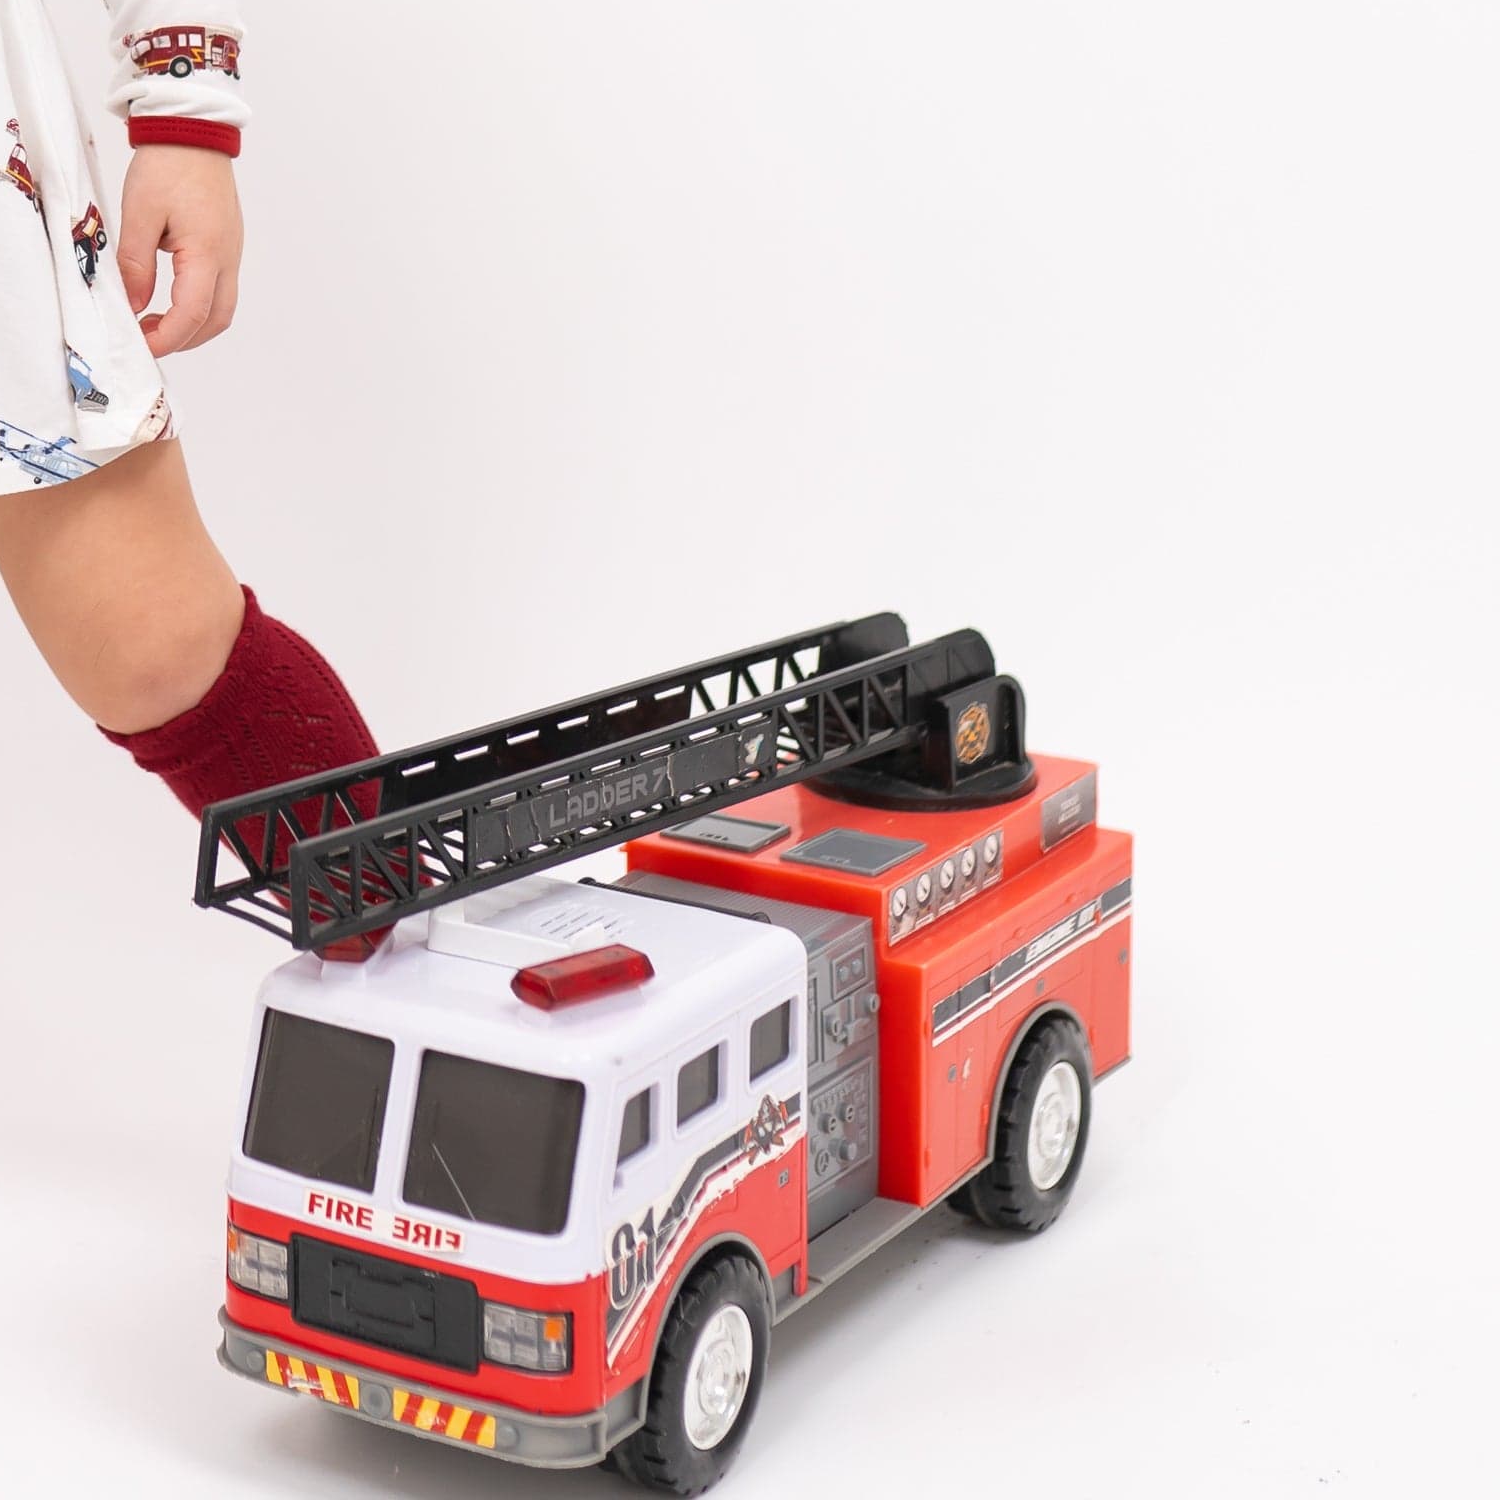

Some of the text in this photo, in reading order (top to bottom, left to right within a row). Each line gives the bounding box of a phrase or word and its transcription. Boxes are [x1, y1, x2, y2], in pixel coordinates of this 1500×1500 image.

[549, 765, 667, 828] LADDER 7
[308, 1192, 374, 1232] FIRE
[611, 1205, 656, 1307] 01
